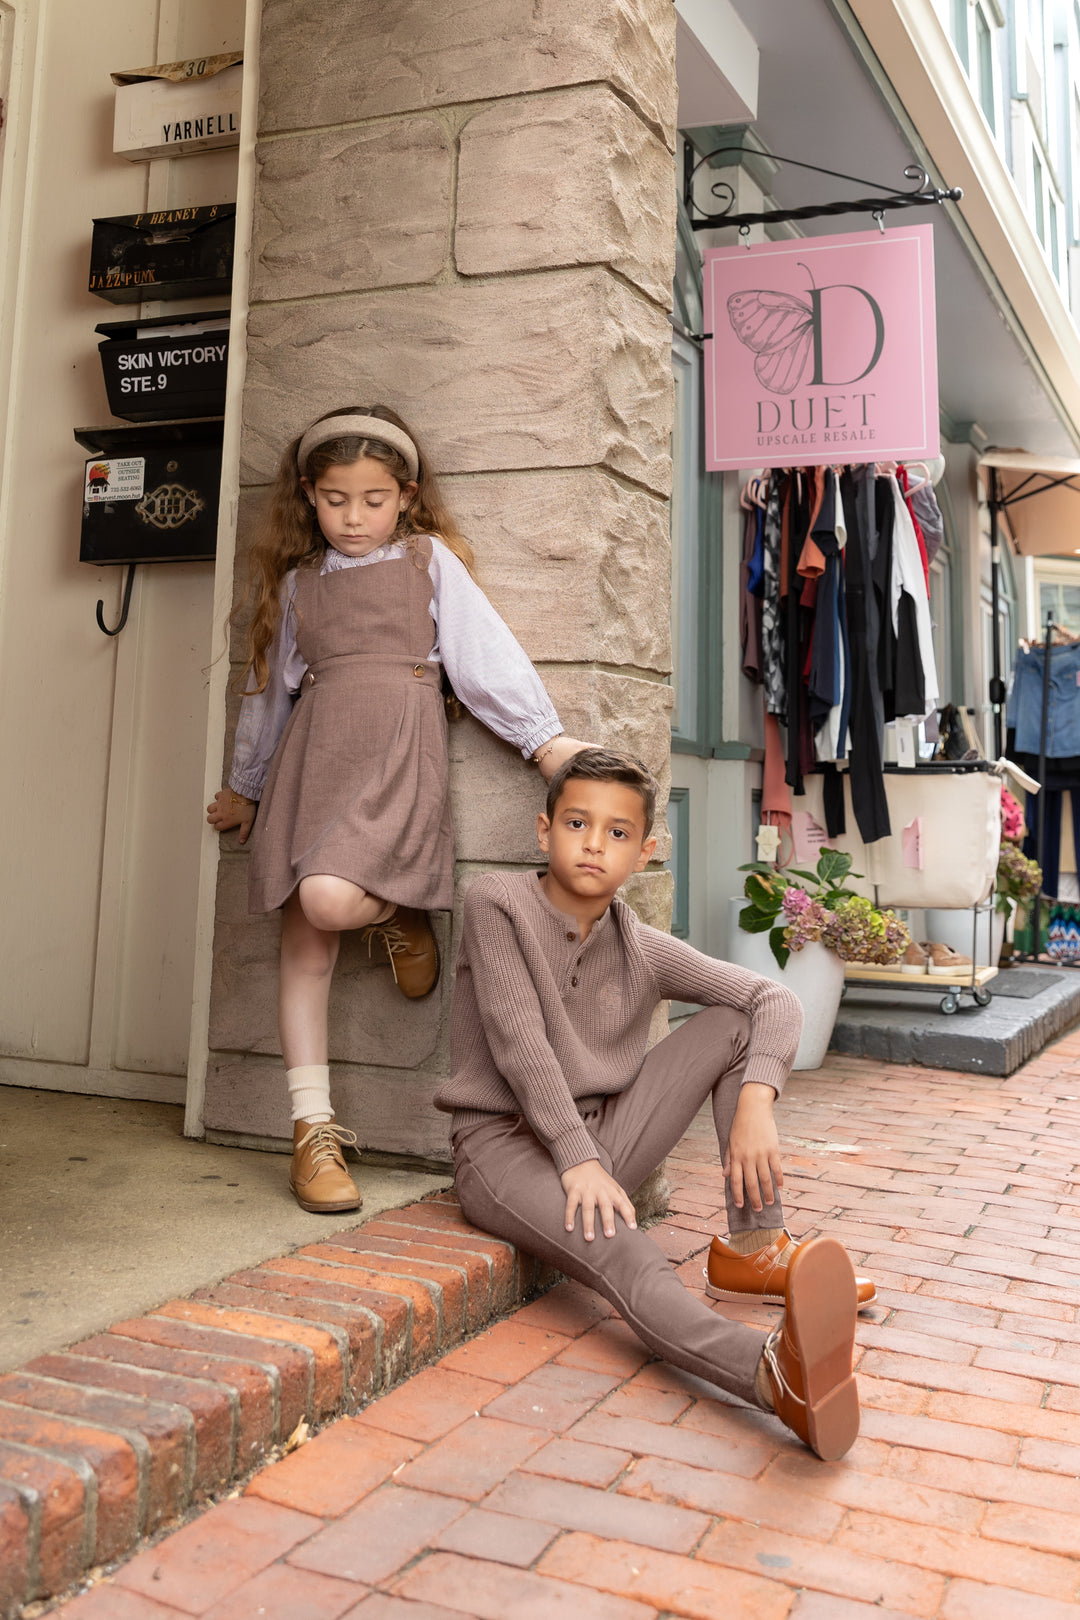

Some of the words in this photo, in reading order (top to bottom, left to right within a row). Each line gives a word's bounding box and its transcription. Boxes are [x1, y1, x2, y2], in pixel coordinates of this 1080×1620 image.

[186, 60, 206, 77] 30
[163, 113, 236, 142] YARNELL
[150, 207, 199, 225] HEANEY
[210, 206, 218, 218] 8
[118, 352, 153, 371] SKIN
[158, 345, 226, 367] VICTORY
[757, 394, 877, 434] DUET
[757, 433, 817, 447] UPSCALE
[824, 429, 876, 443] RESALE
